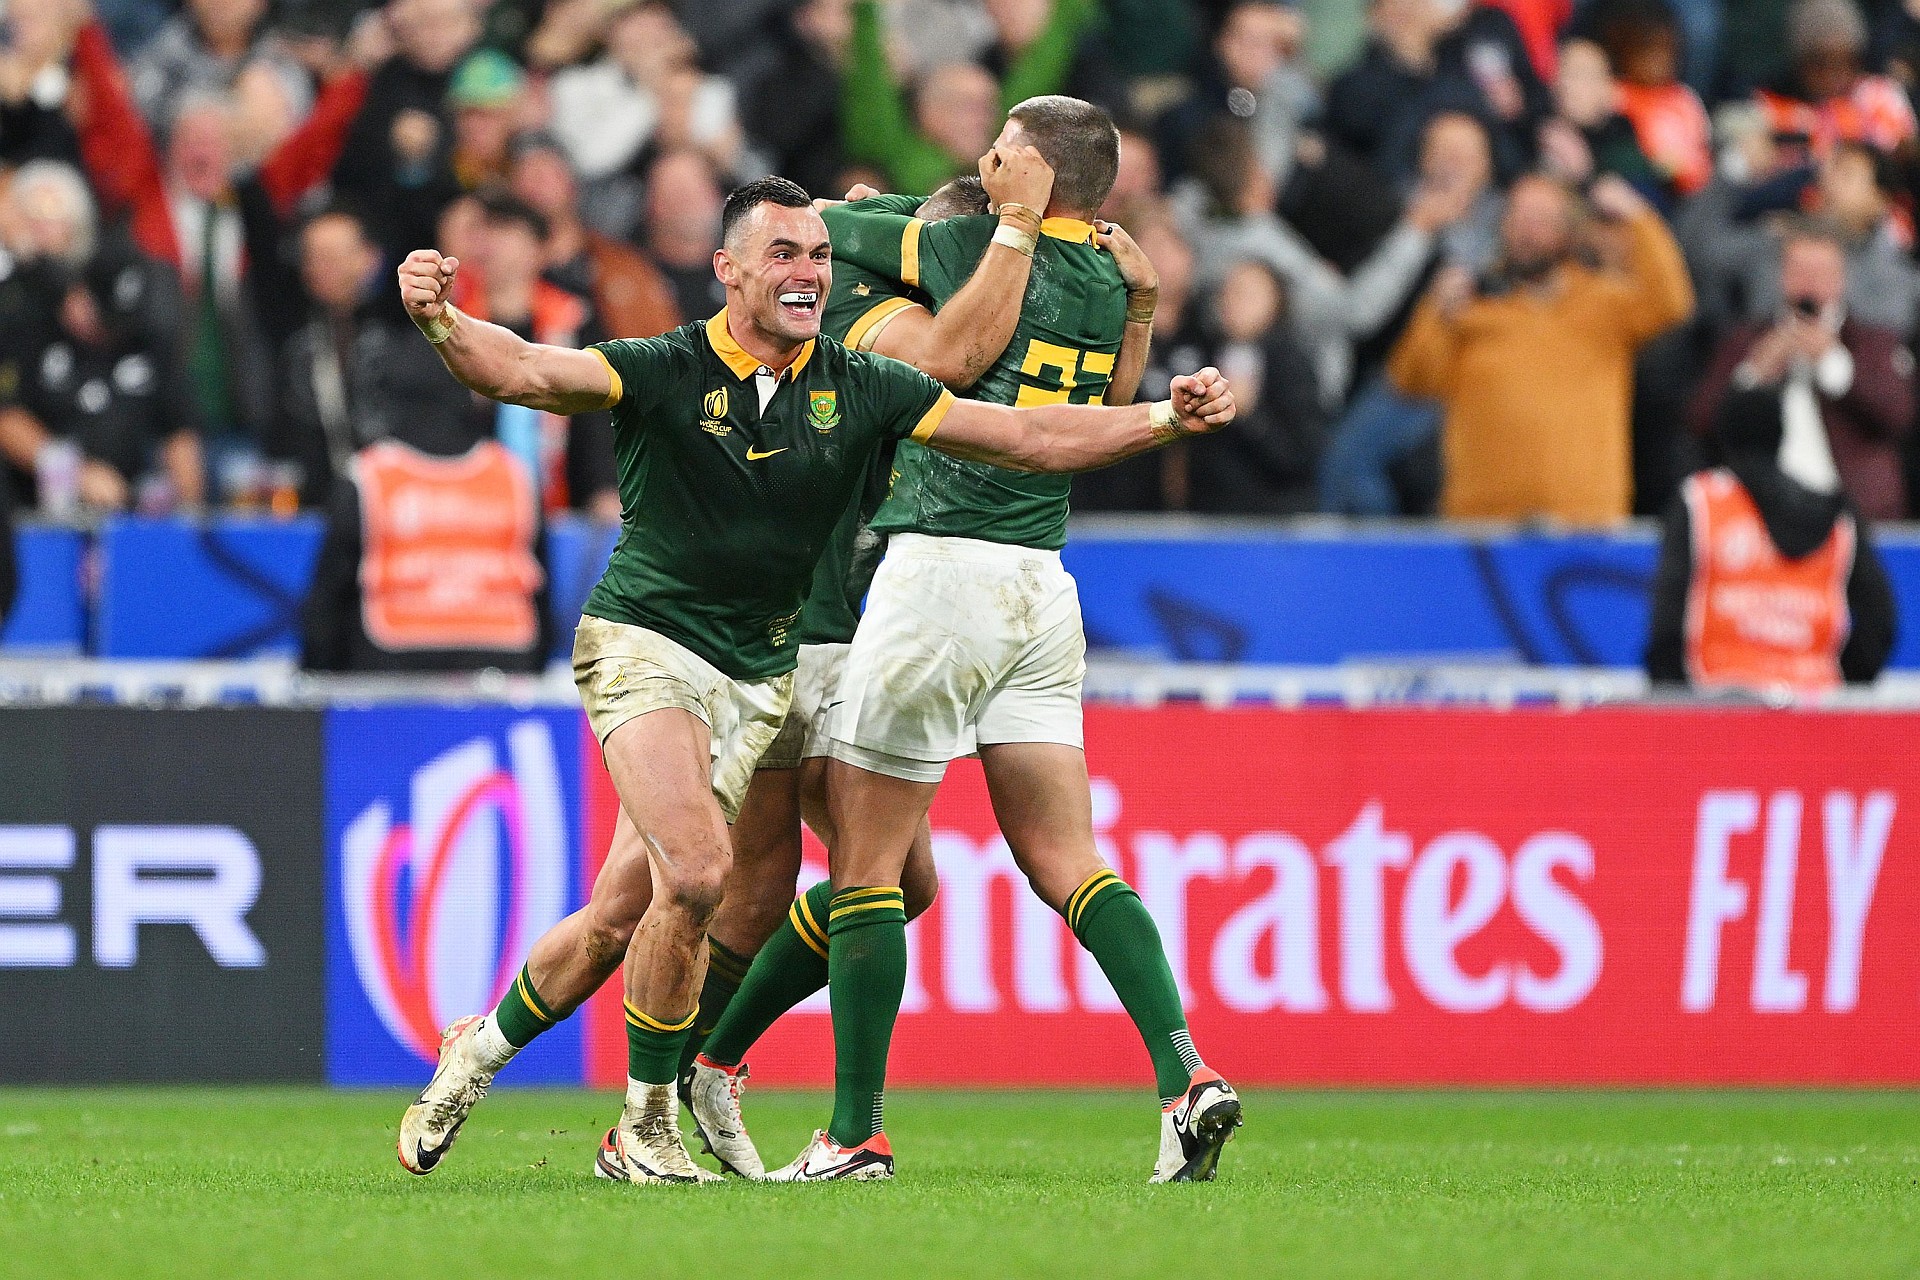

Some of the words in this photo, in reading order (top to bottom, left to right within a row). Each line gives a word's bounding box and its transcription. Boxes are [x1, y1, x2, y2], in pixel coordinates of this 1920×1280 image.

[719, 425, 732, 433] CUP
[783, 778, 1602, 1014] mirates
[1681, 788, 1897, 1013] FLY
